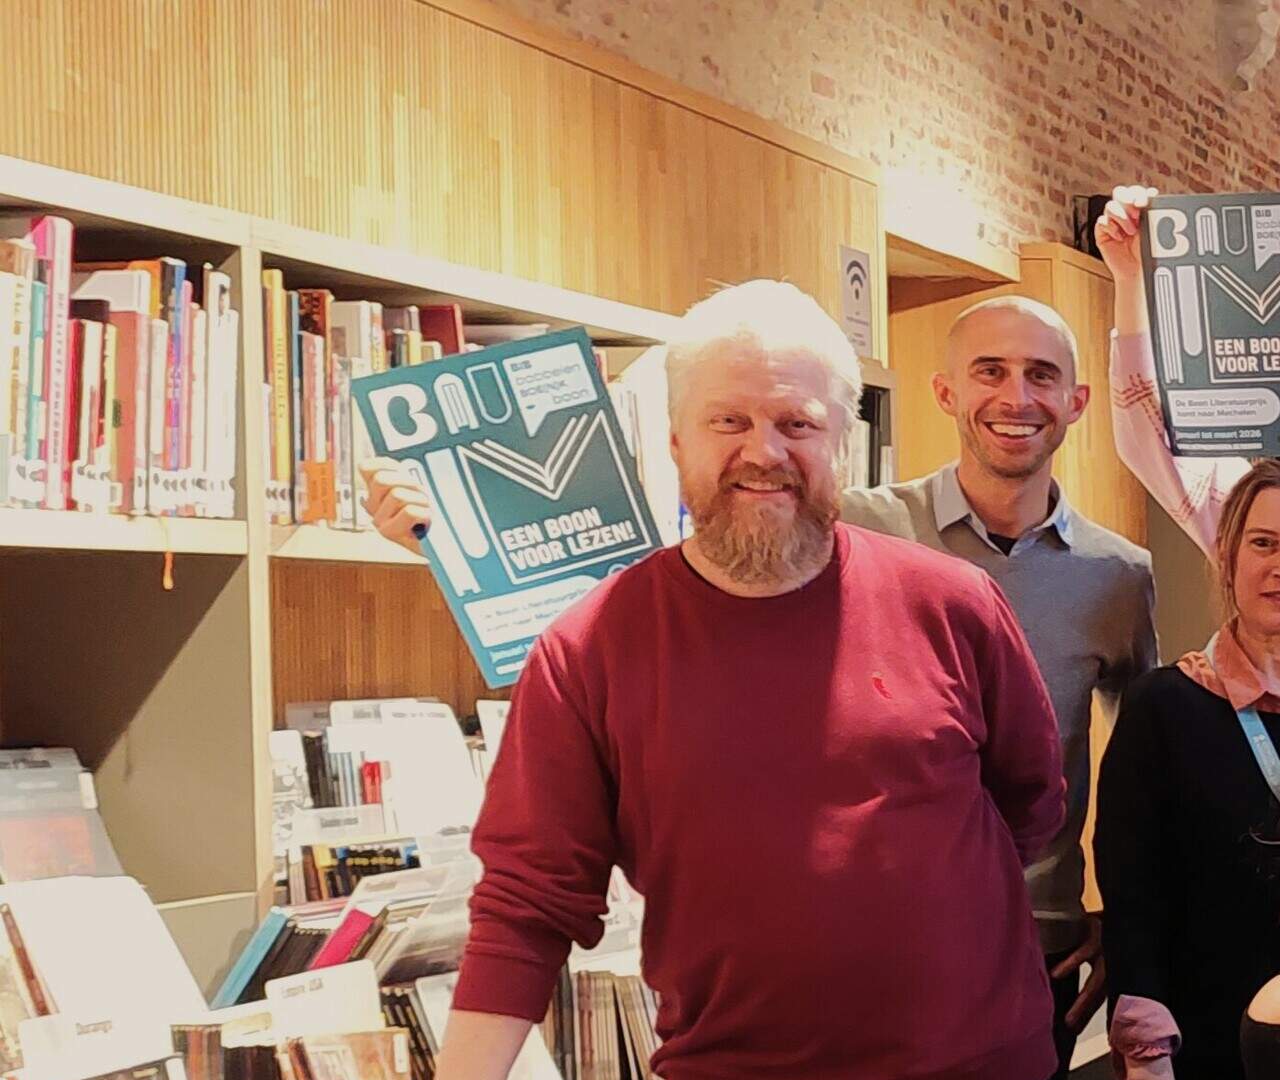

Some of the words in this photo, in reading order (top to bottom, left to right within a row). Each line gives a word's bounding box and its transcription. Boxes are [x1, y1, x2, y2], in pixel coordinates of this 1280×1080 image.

[1214, 339, 1245, 355] EEN
[1216, 356, 1259, 373] VOOR
[500, 519, 545, 551] EEN
[543, 506, 603, 541] BOON
[508, 540, 564, 571] VOOR
[568, 520, 637, 556] LEZEN!
